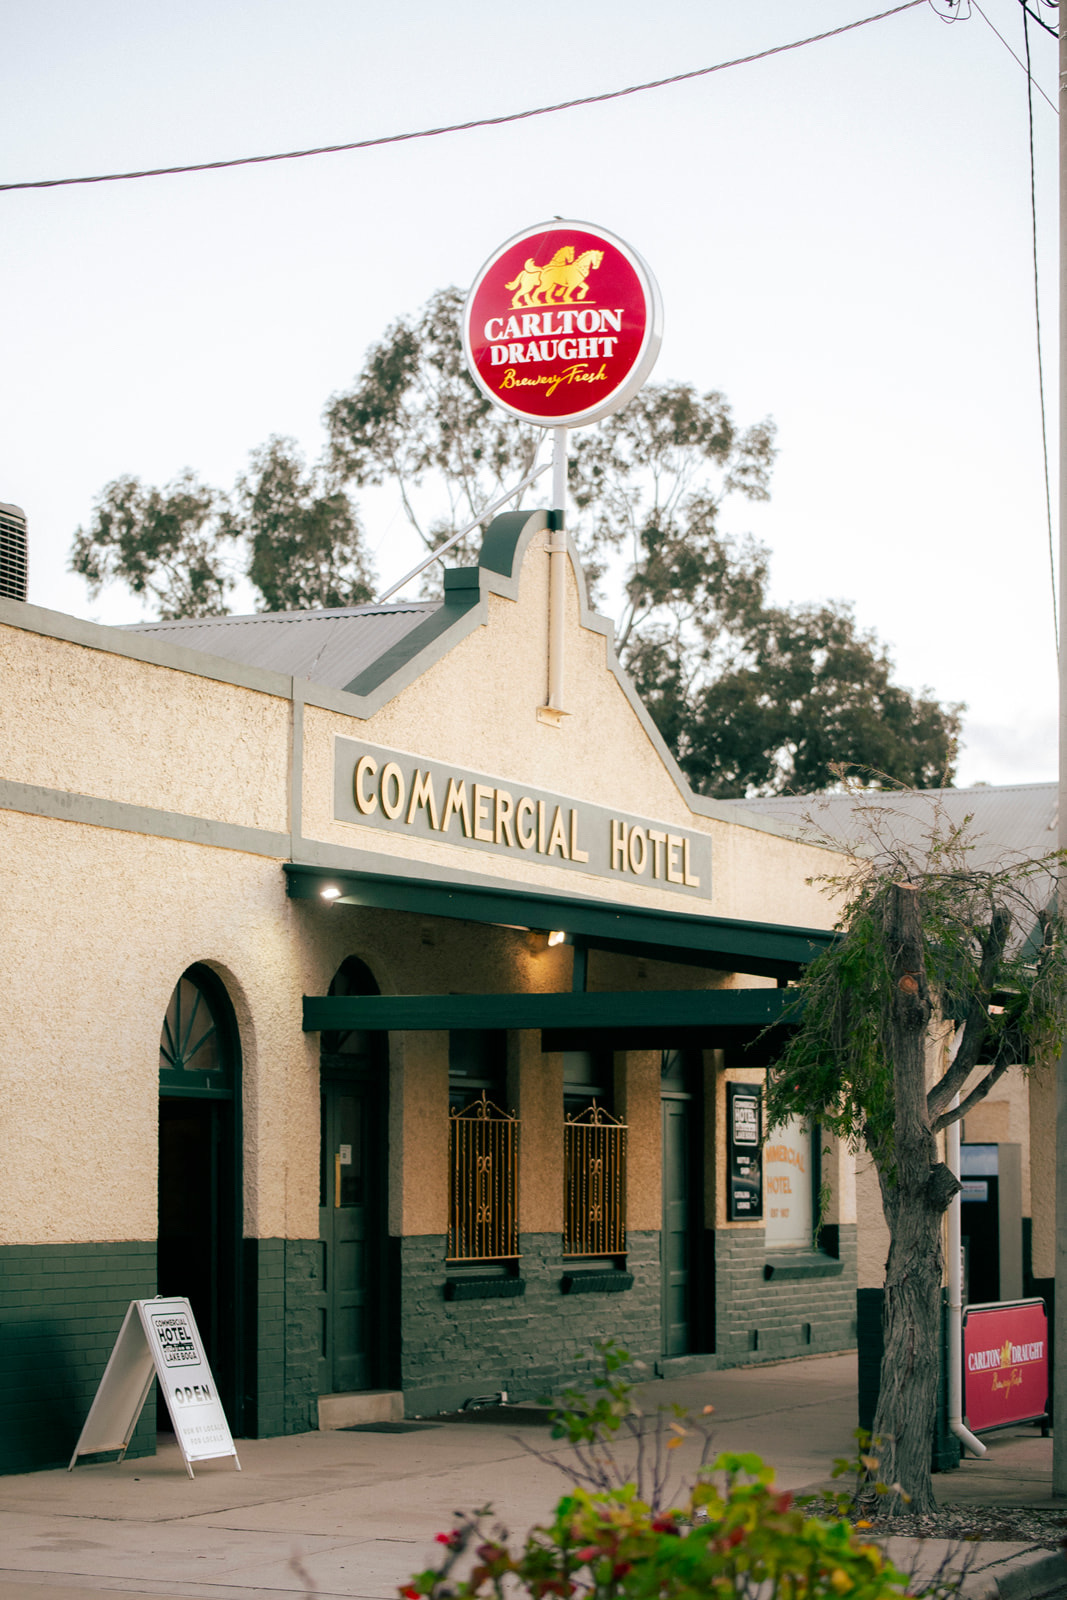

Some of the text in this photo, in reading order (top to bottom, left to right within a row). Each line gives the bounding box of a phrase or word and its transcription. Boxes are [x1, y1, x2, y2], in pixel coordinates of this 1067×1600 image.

[484, 309, 624, 341] CARLTON
[490, 336, 618, 366] DRAUGHT
[499, 363, 608, 397] Brewery Fresh
[354, 755, 701, 887] COMMERCIAL HOTEL
[767, 1176, 792, 1194] HOTEL
[155, 1318, 187, 1327] COMMERCIAL
[157, 1326, 191, 1342] HOTEL
[165, 1351, 197, 1362] LAKE BOGA
[968, 1341, 1043, 1371] CARLTON DRAUGHT
[174, 1384, 213, 1405] OPEN
